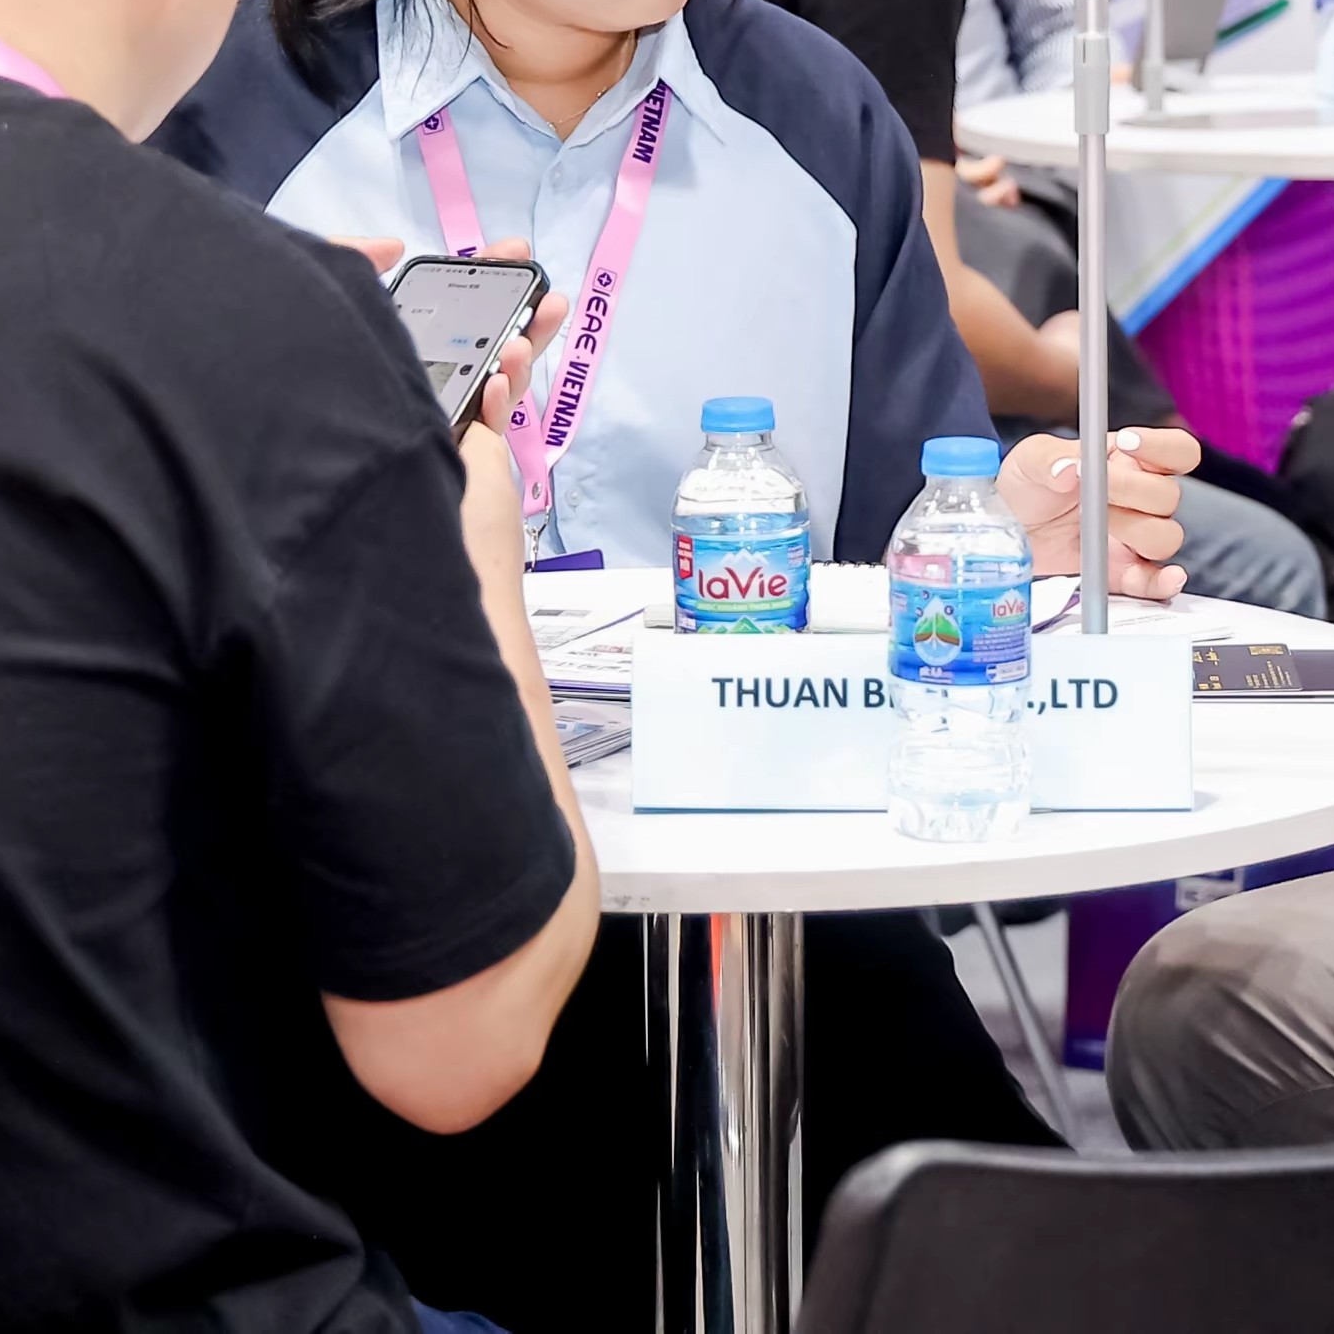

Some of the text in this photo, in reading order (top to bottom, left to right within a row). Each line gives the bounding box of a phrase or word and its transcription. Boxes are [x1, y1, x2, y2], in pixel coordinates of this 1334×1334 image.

[545, 288, 611, 448] IEAE VIETNAM
[698, 566, 788, 600] laVie
[711, 677, 849, 709] THUAN
[1025, 677, 1119, 715] .,LTD
